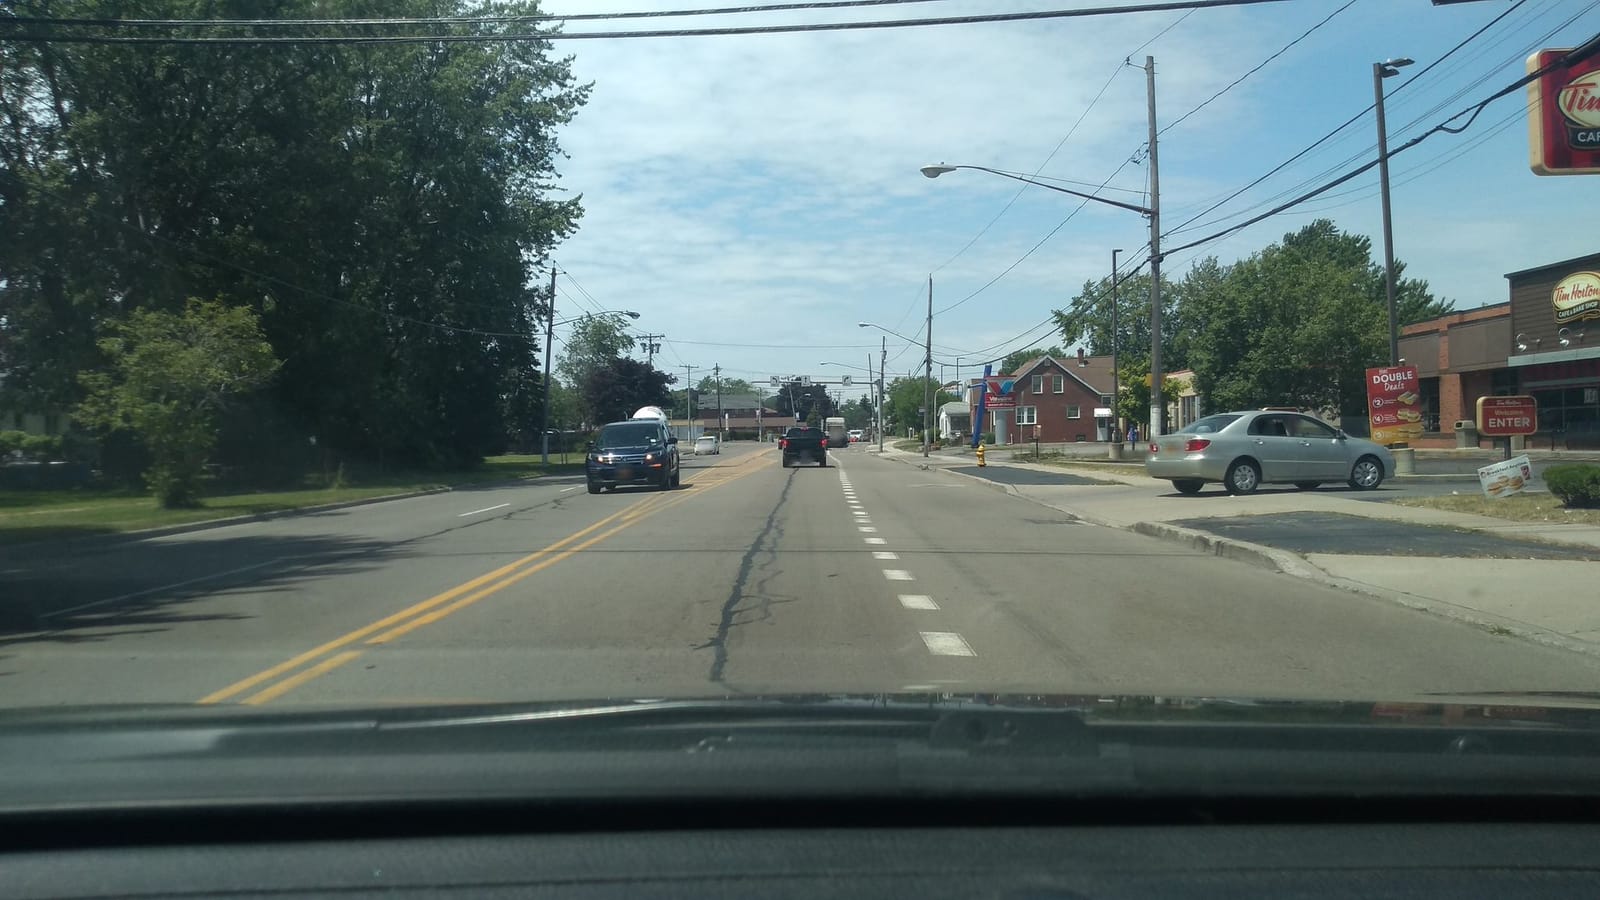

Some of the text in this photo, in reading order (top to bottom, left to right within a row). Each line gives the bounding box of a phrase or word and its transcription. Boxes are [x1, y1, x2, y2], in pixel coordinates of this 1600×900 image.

[1555, 286, 1570, 302] Tim
[1373, 370, 1413, 384] DOUBLE
[1384, 381, 1404, 391] Deals
[1488, 417, 1530, 428] ENTER
